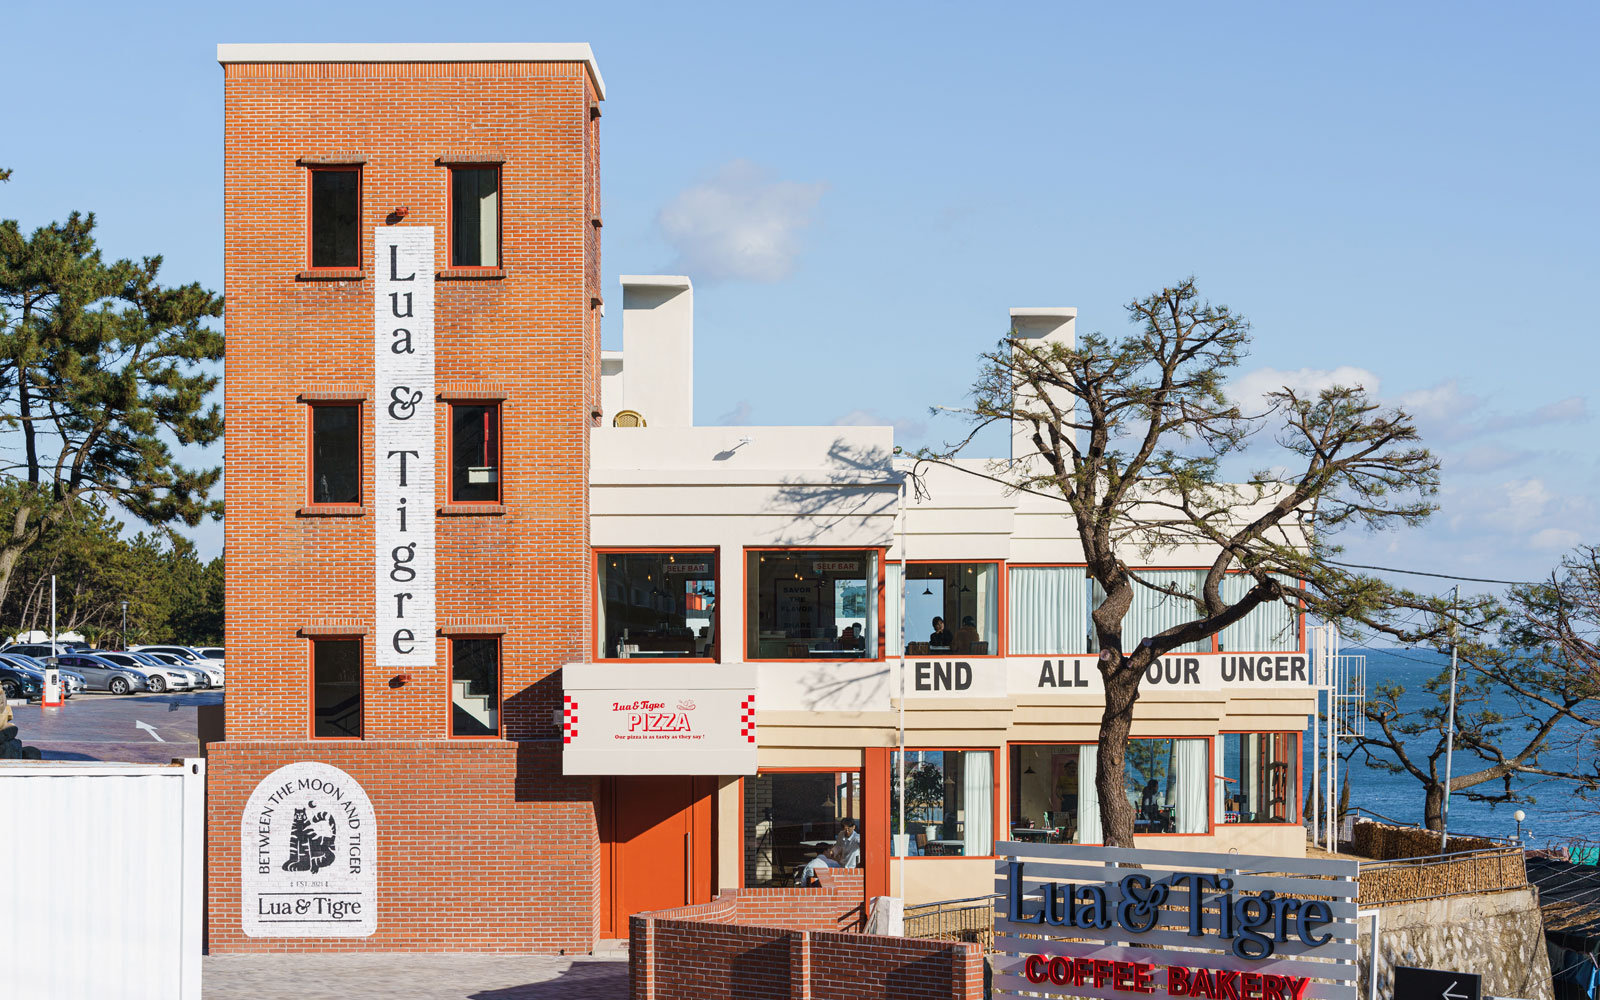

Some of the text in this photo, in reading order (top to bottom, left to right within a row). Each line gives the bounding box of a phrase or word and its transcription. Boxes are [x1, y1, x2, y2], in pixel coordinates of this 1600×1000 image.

[386, 244, 424, 655] Lua & Tigre
[816, 562, 855, 570] SELF BAR
[915, 656, 1307, 691] END ALL OUR UNGER
[628, 712, 691, 731] PIZZA
[258, 778, 362, 875] BETWEEN THE MOON AND TIGER
[312, 897, 362, 920] Tigre
[1008, 862, 1112, 930] Lua
[1171, 872, 1335, 961] Tigre
[1025, 954, 1311, 1000] COFFEE BAKERY
